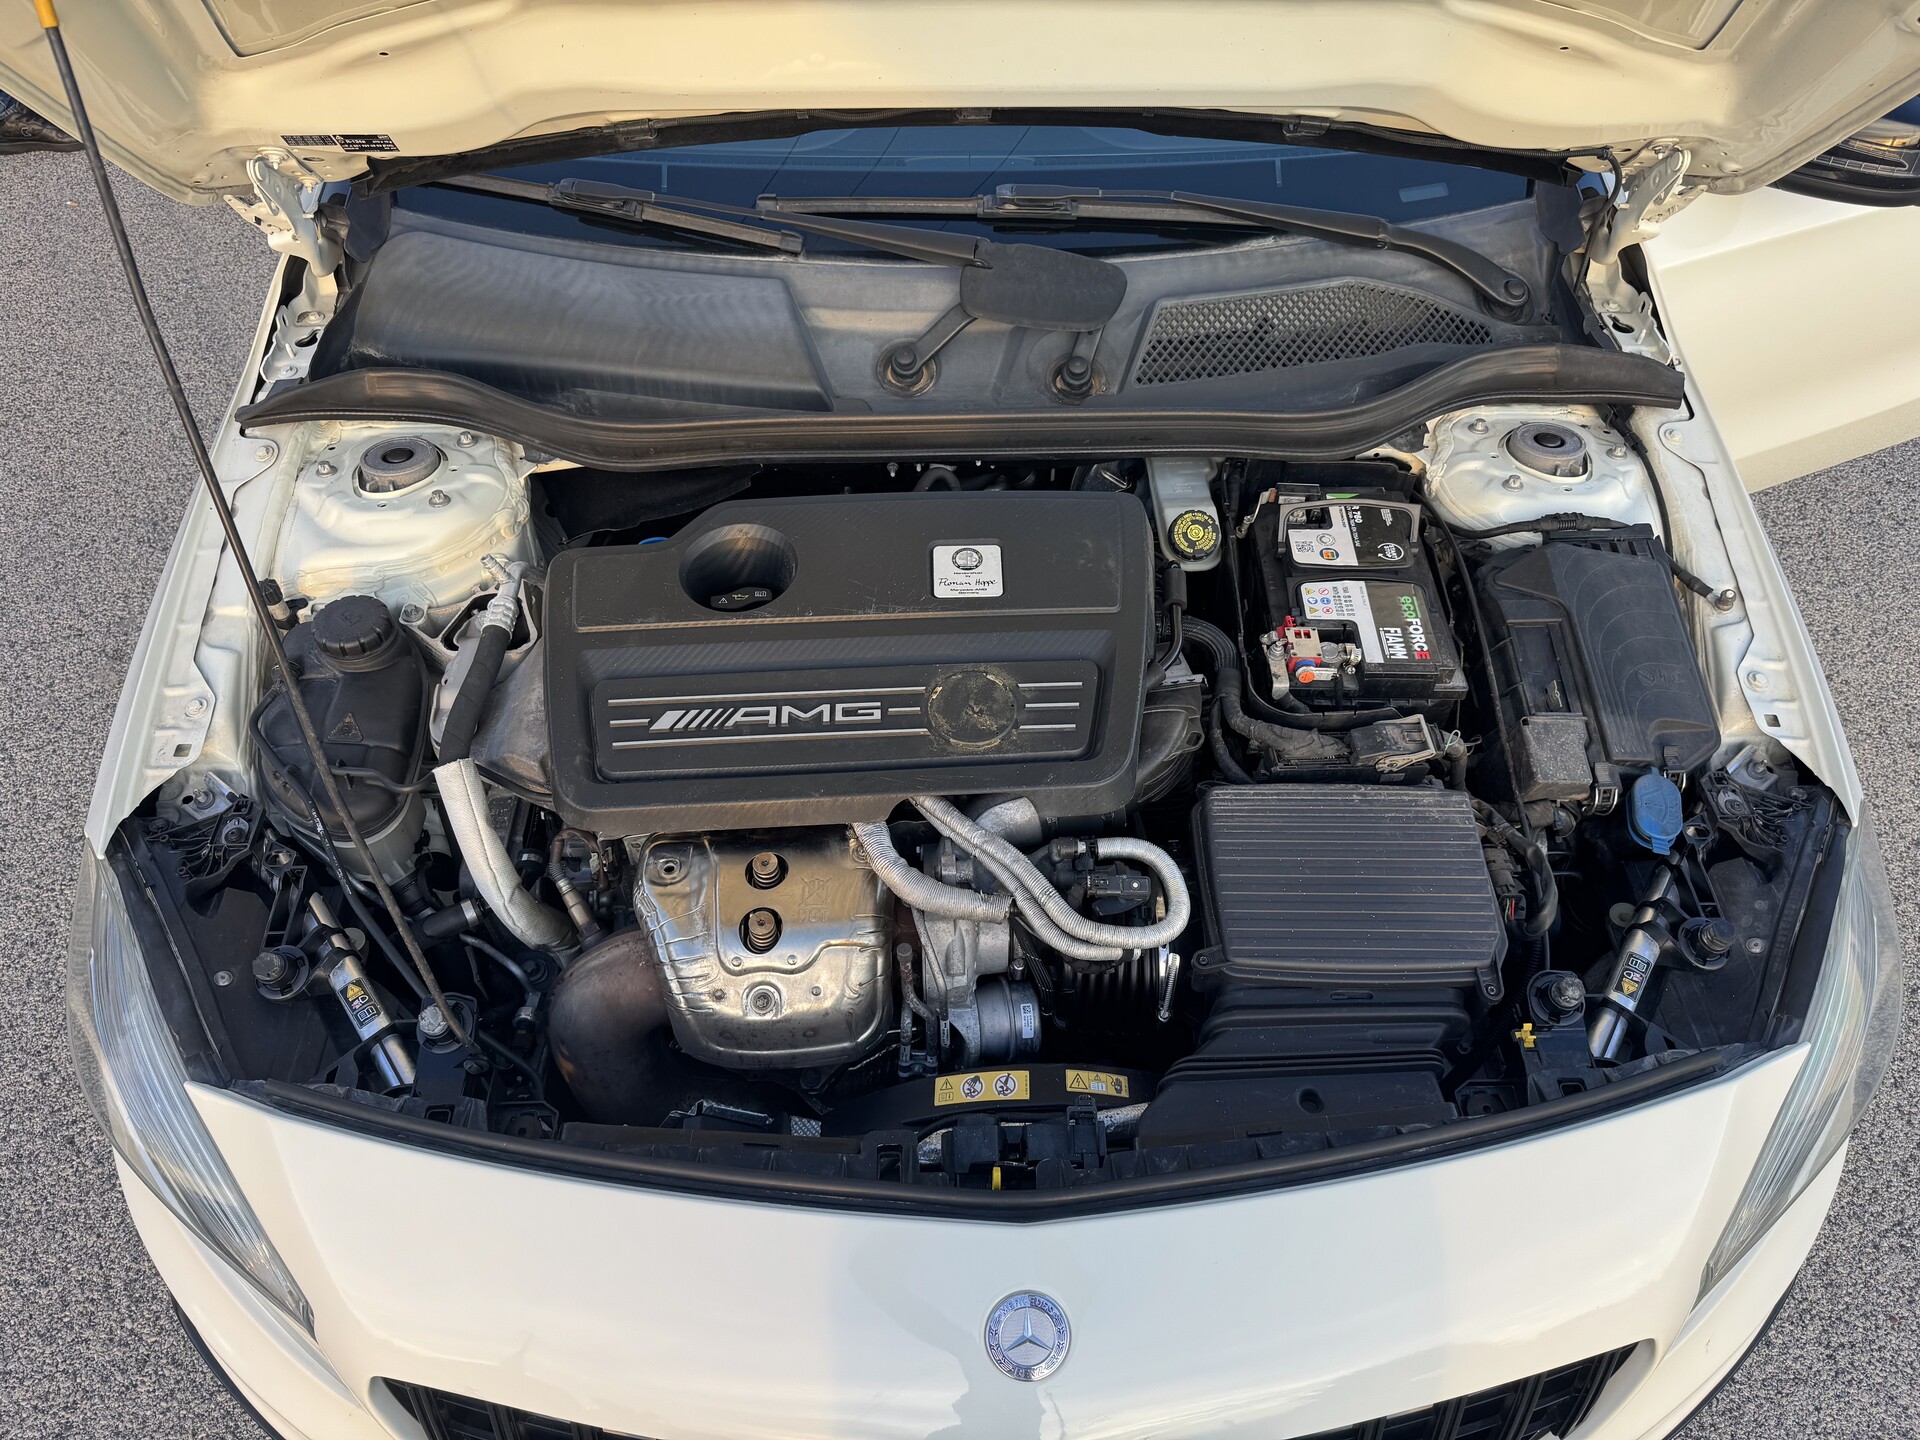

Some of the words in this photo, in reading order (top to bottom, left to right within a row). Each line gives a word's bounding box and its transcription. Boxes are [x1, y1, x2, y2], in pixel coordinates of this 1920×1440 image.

[1383, 627, 1409, 660] FIAMM
[724, 701, 882, 729] AMG
[1000, 1295, 1054, 1316] MERCEDES
[1013, 1366, 1045, 1379] BENZ
